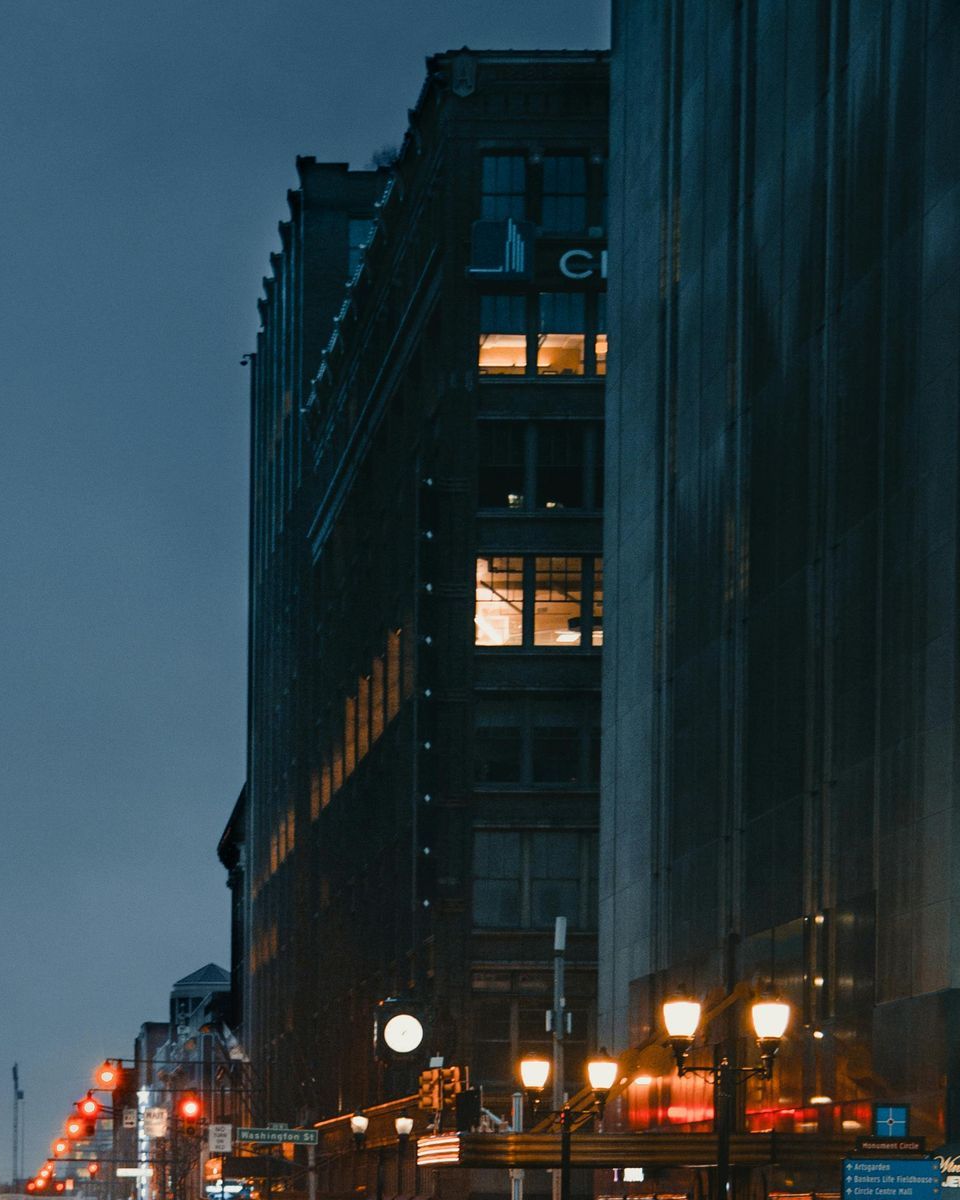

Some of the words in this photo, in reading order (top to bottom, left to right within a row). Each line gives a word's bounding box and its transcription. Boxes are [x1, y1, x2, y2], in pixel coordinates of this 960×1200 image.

[240, 1131, 300, 1142] Washington
[303, 1132, 315, 1141] St
[862, 1142, 897, 1150] Monument
[899, 1142, 919, 1150] Circle
[854, 1163, 891, 1172] Artsgarden
[854, 1175, 881, 1183] Bankers
[882, 1175, 895, 1183] Life
[897, 1175, 933, 1183] Fieldhouse
[854, 1187, 873, 1195] Circle
[898, 1187, 913, 1195] Mall
